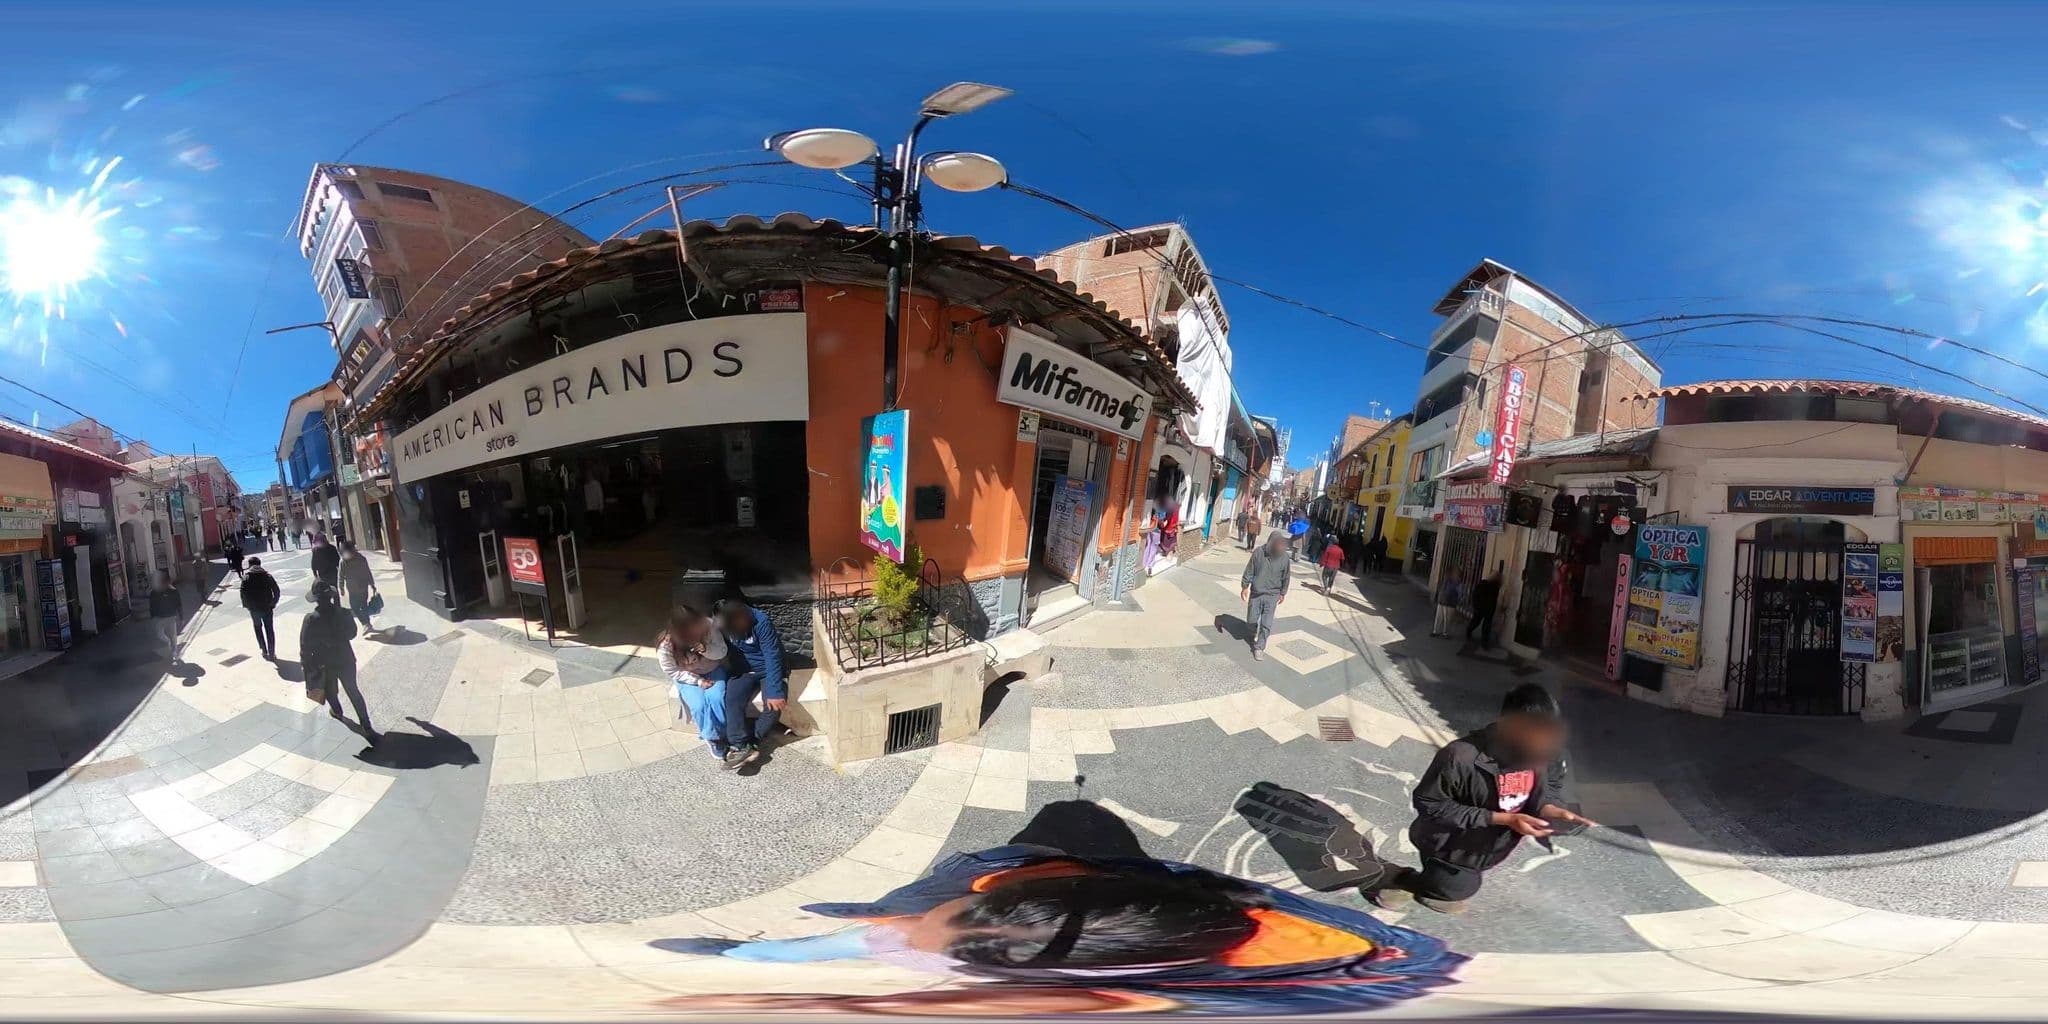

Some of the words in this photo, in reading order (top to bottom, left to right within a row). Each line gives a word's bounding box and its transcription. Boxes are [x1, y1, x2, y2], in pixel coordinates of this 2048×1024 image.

[403, 400, 504, 462] AMERICAN
[524, 342, 743, 416] BRANDS
[1010, 352, 1120, 419] Mifarma
[485, 433, 515, 453] store
[1495, 382, 1522, 477] BOTICAS
[1749, 489, 1792, 501] EDGAR
[1797, 491, 1875, 503] ADVENTURES
[512, 548, 538, 569] 50
[1631, 587, 1660, 600] OPTICA
[1607, 563, 1627, 674] OPTICA
